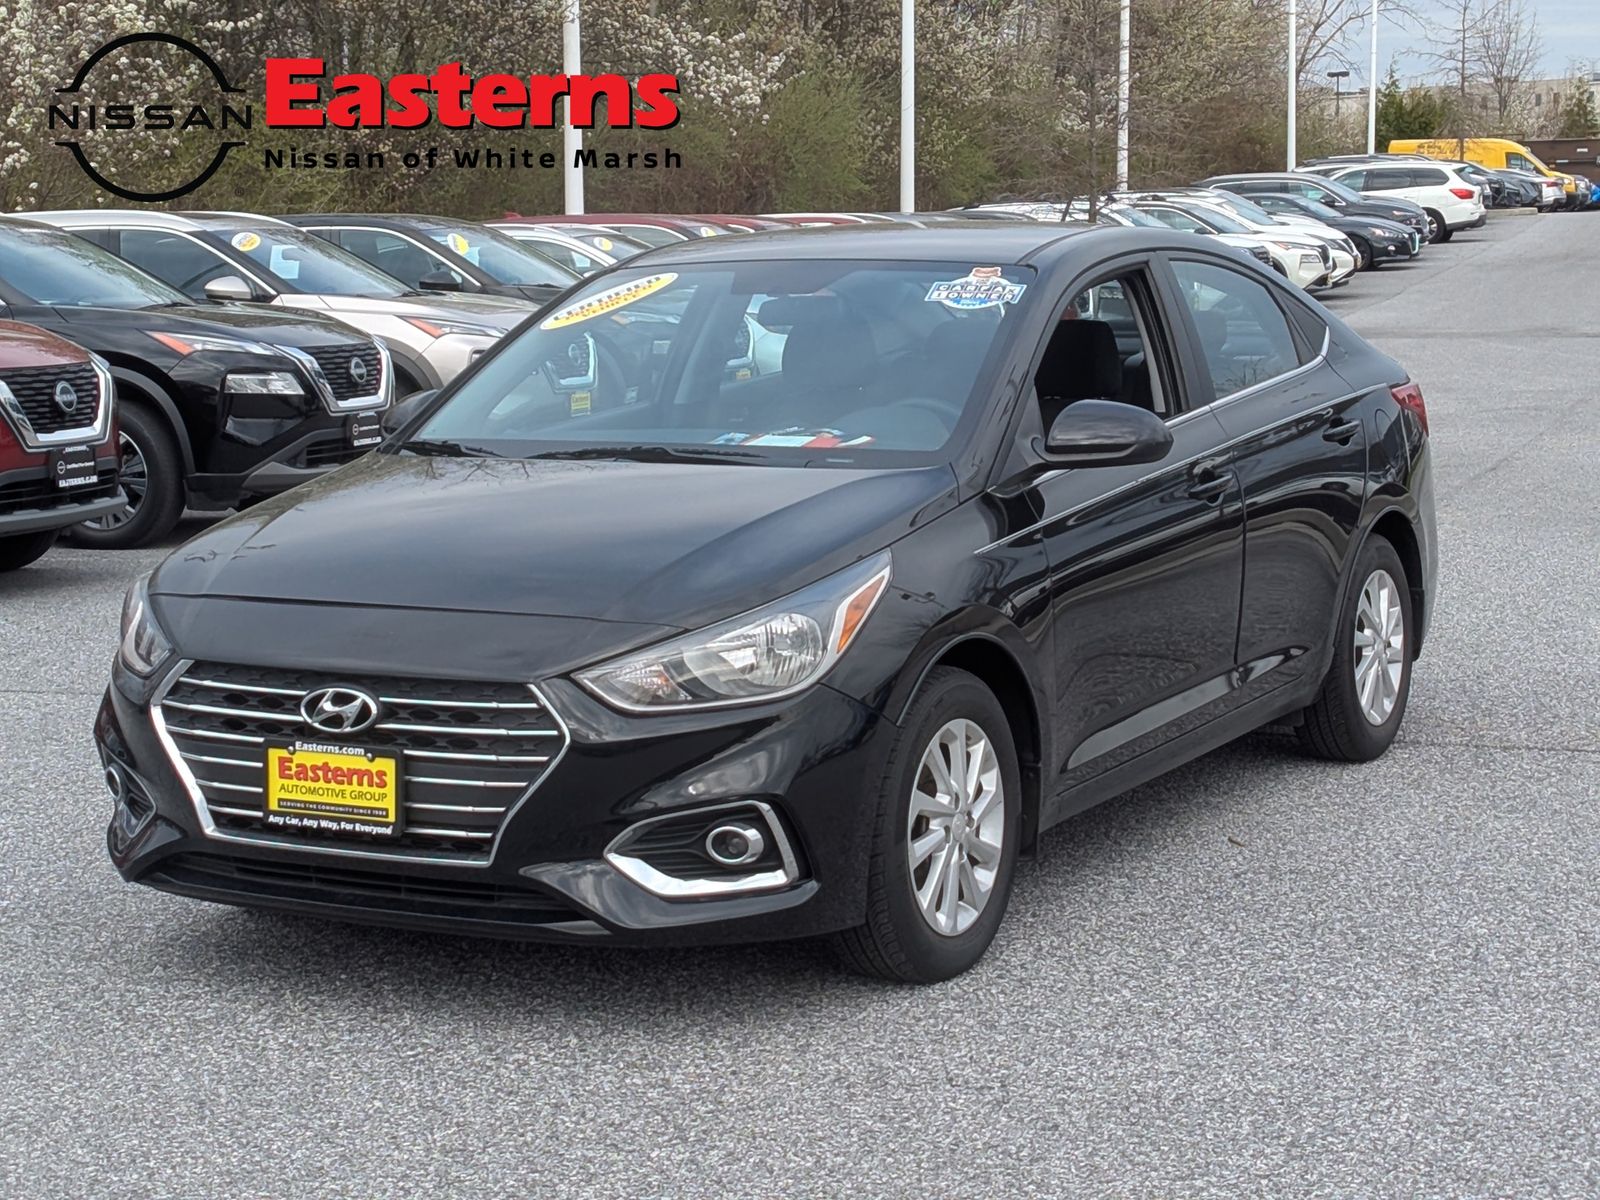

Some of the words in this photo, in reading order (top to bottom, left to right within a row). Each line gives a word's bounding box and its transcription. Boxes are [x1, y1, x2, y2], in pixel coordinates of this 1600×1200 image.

[295, 741, 365, 755] Easterns.com
[277, 756, 388, 789] Easterns
[279, 783, 347, 799] AUTOMOTIVE
[350, 790, 387, 802] GROUP
[318, 804, 353, 813] COMMUNITY
[268, 814, 285, 825] Any
[285, 815, 302, 827] Car,
[302, 817, 318, 829] Any
[319, 820, 340, 830] Way,
[340, 822, 354, 830] For
